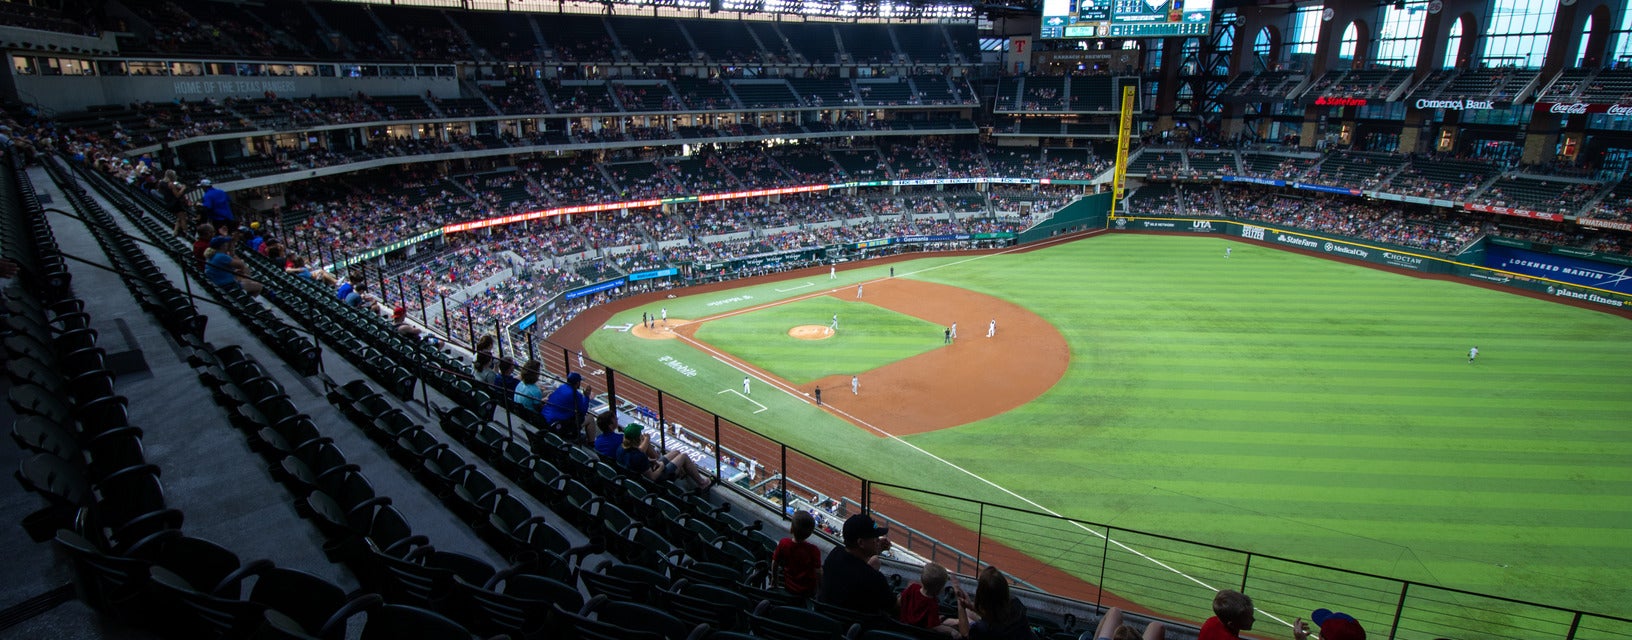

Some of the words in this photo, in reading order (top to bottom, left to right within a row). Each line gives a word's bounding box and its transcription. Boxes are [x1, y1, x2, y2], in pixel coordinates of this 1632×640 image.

[174, 81, 201, 94] HOME
[203, 81, 216, 94] OF
[218, 81, 234, 93] THE
[235, 80, 260, 92] TEXAS
[261, 80, 296, 92] RANGERS
[1465, 99, 1494, 110] Bank
[1550, 102, 1590, 114] Coca-Cola
[1193, 220, 1211, 229] UTA
[1580, 218, 1631, 231] WHATABURGER
[1242, 230, 1265, 241] SELTZER
[1385, 252, 1423, 264] CHOCTAW
[1509, 258, 1560, 272] LOCKHEED
[1562, 267, 1604, 280] MARTIN
[1556, 288, 1588, 300] planet
[1588, 294, 1623, 307] fitness
